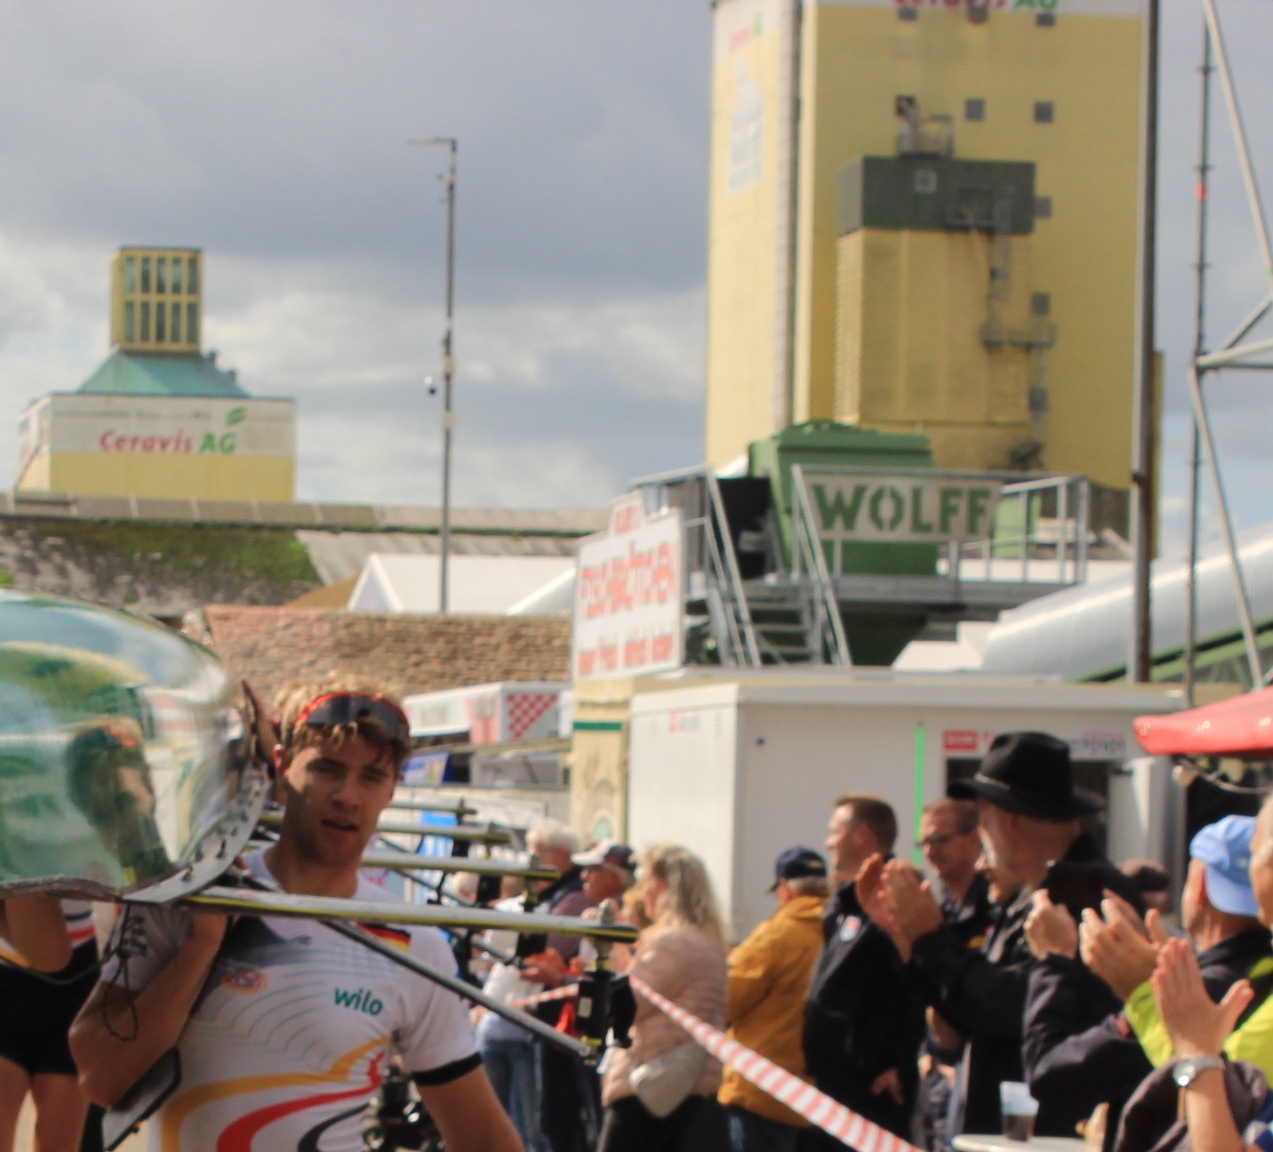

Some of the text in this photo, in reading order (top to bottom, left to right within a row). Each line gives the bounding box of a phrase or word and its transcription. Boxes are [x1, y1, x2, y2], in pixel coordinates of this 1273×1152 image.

[100, 429, 236, 455] Ceravis AG
[811, 483, 992, 535] WOLFF
[335, 988, 383, 1016] wilo
